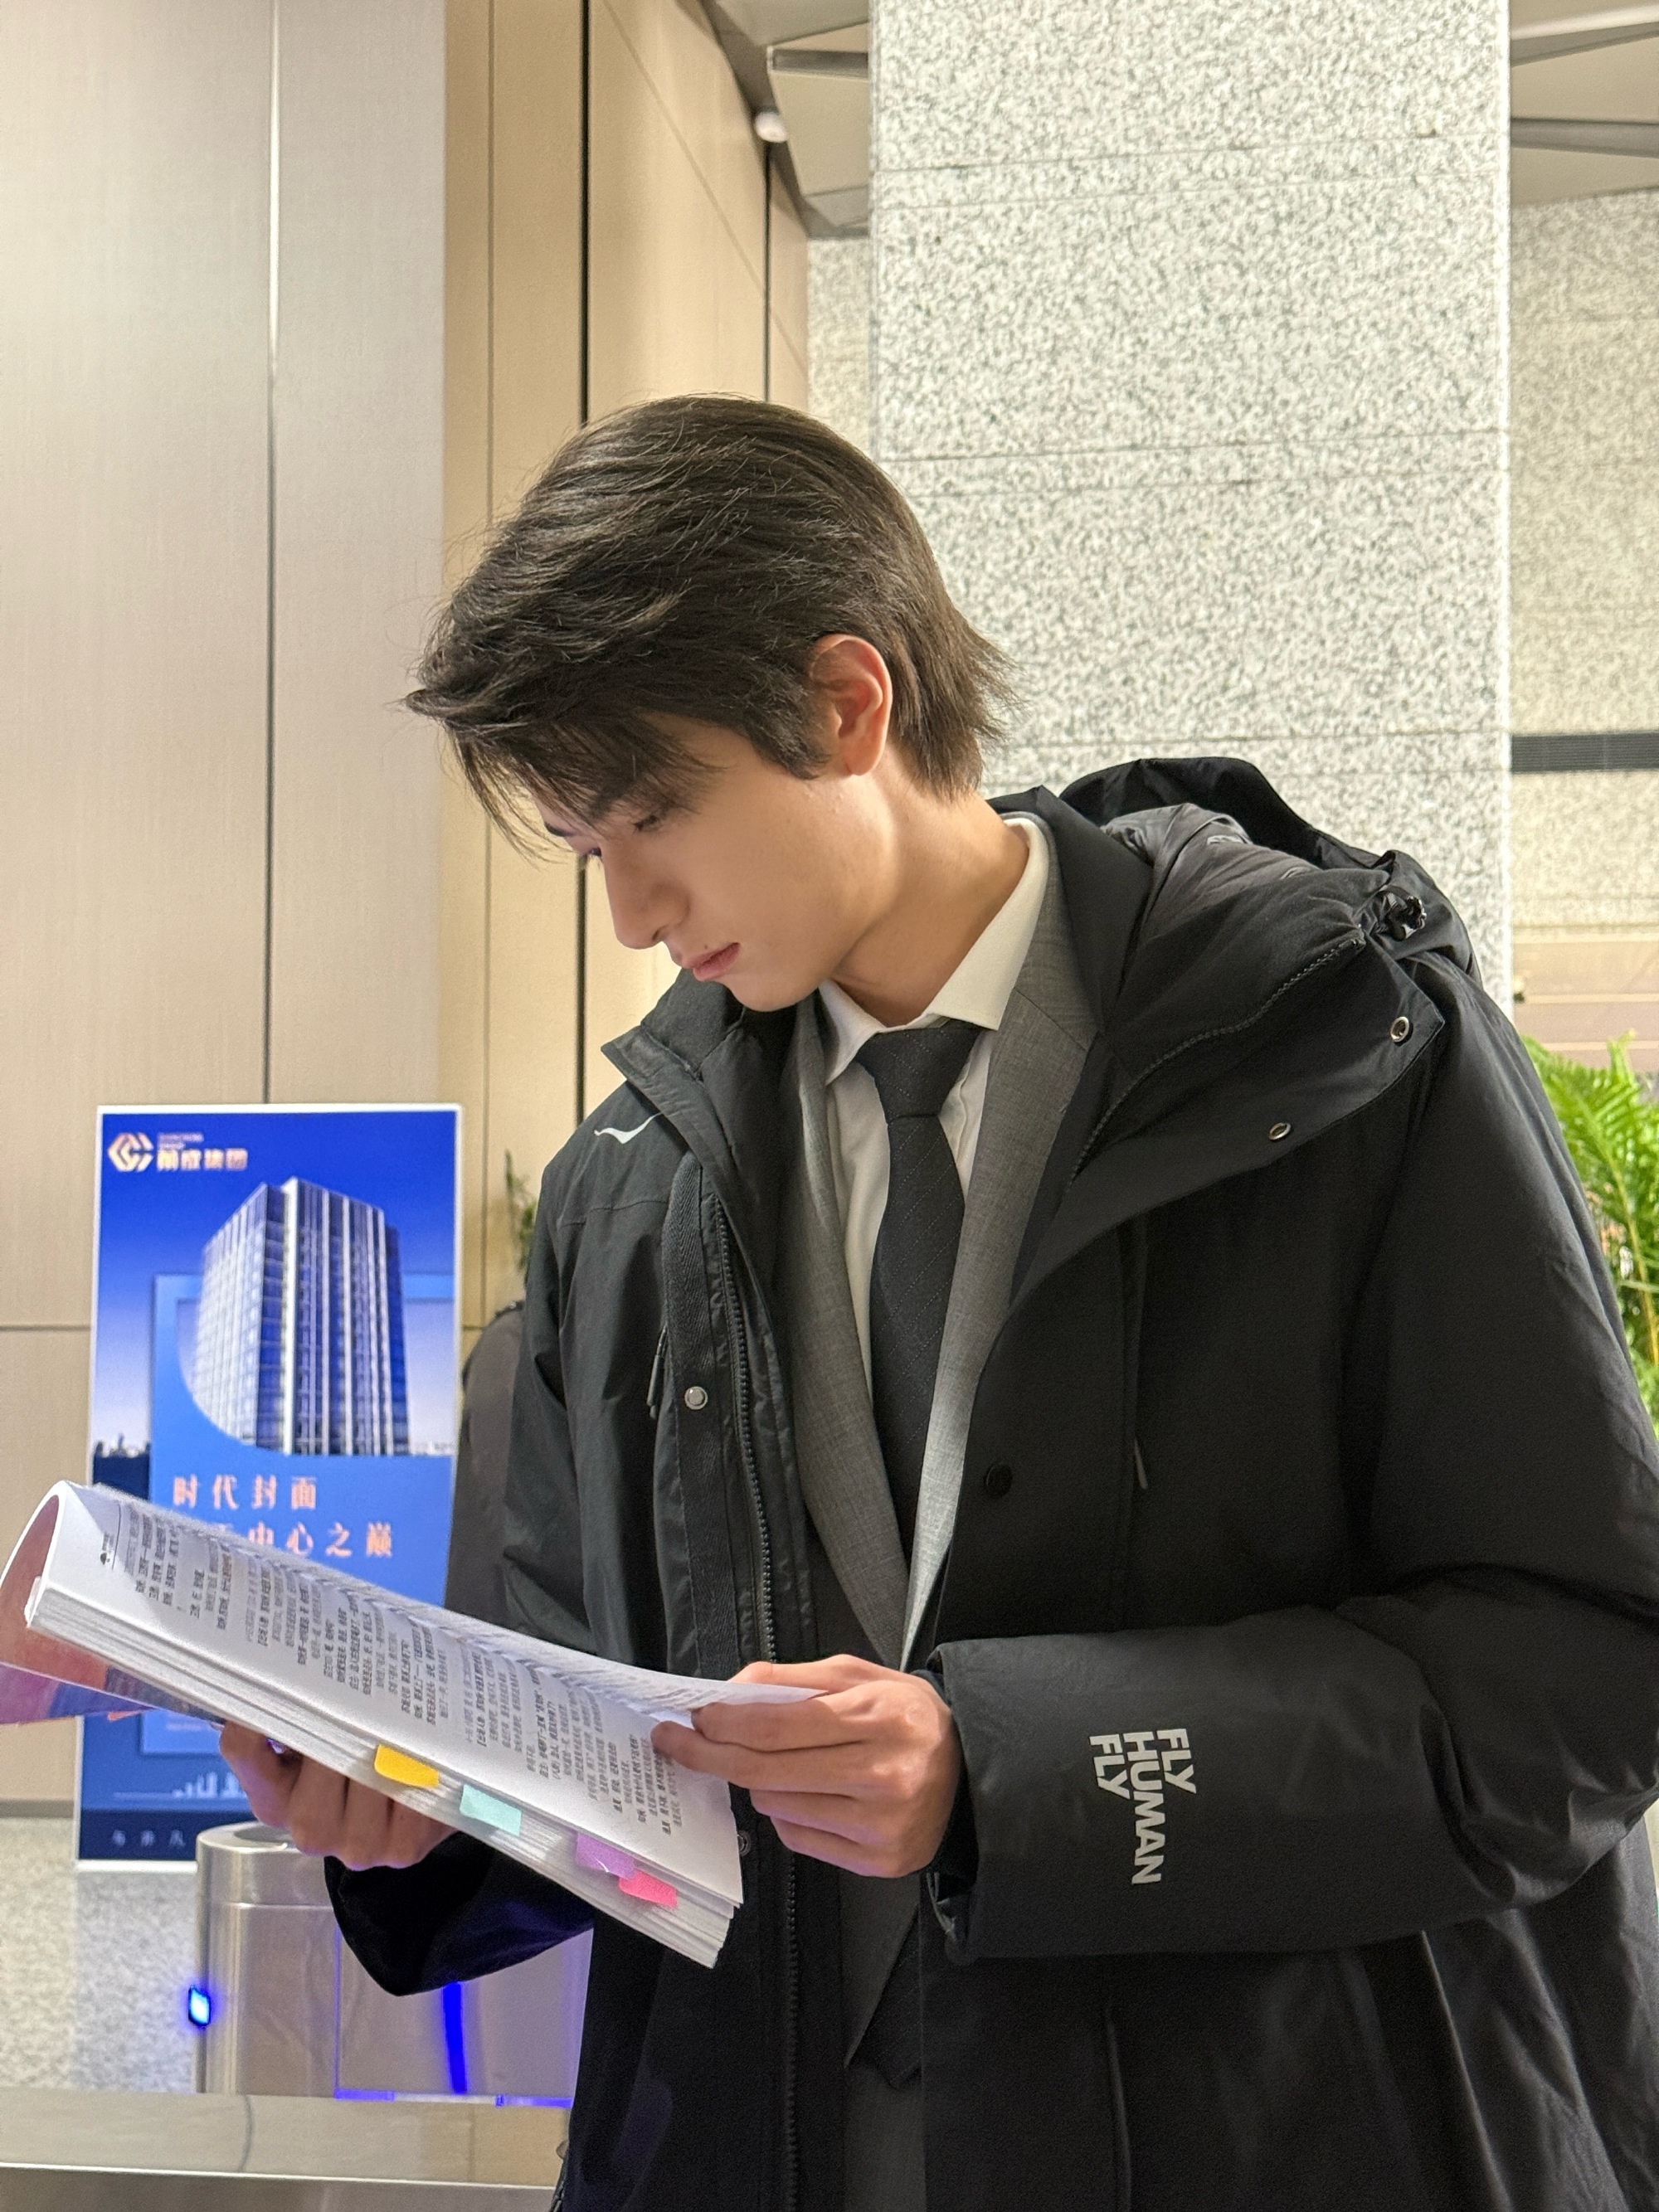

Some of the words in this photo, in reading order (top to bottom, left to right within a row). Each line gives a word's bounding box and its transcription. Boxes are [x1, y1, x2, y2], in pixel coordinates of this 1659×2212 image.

[173, 1474, 317, 1510] 时代封面
[209, 1519, 392, 1558] 中心之巅
[1089, 1733, 1131, 1800] FLY
[1156, 1728, 1197, 1794] FLY
[1122, 1731, 1165, 1884] HUMAN
